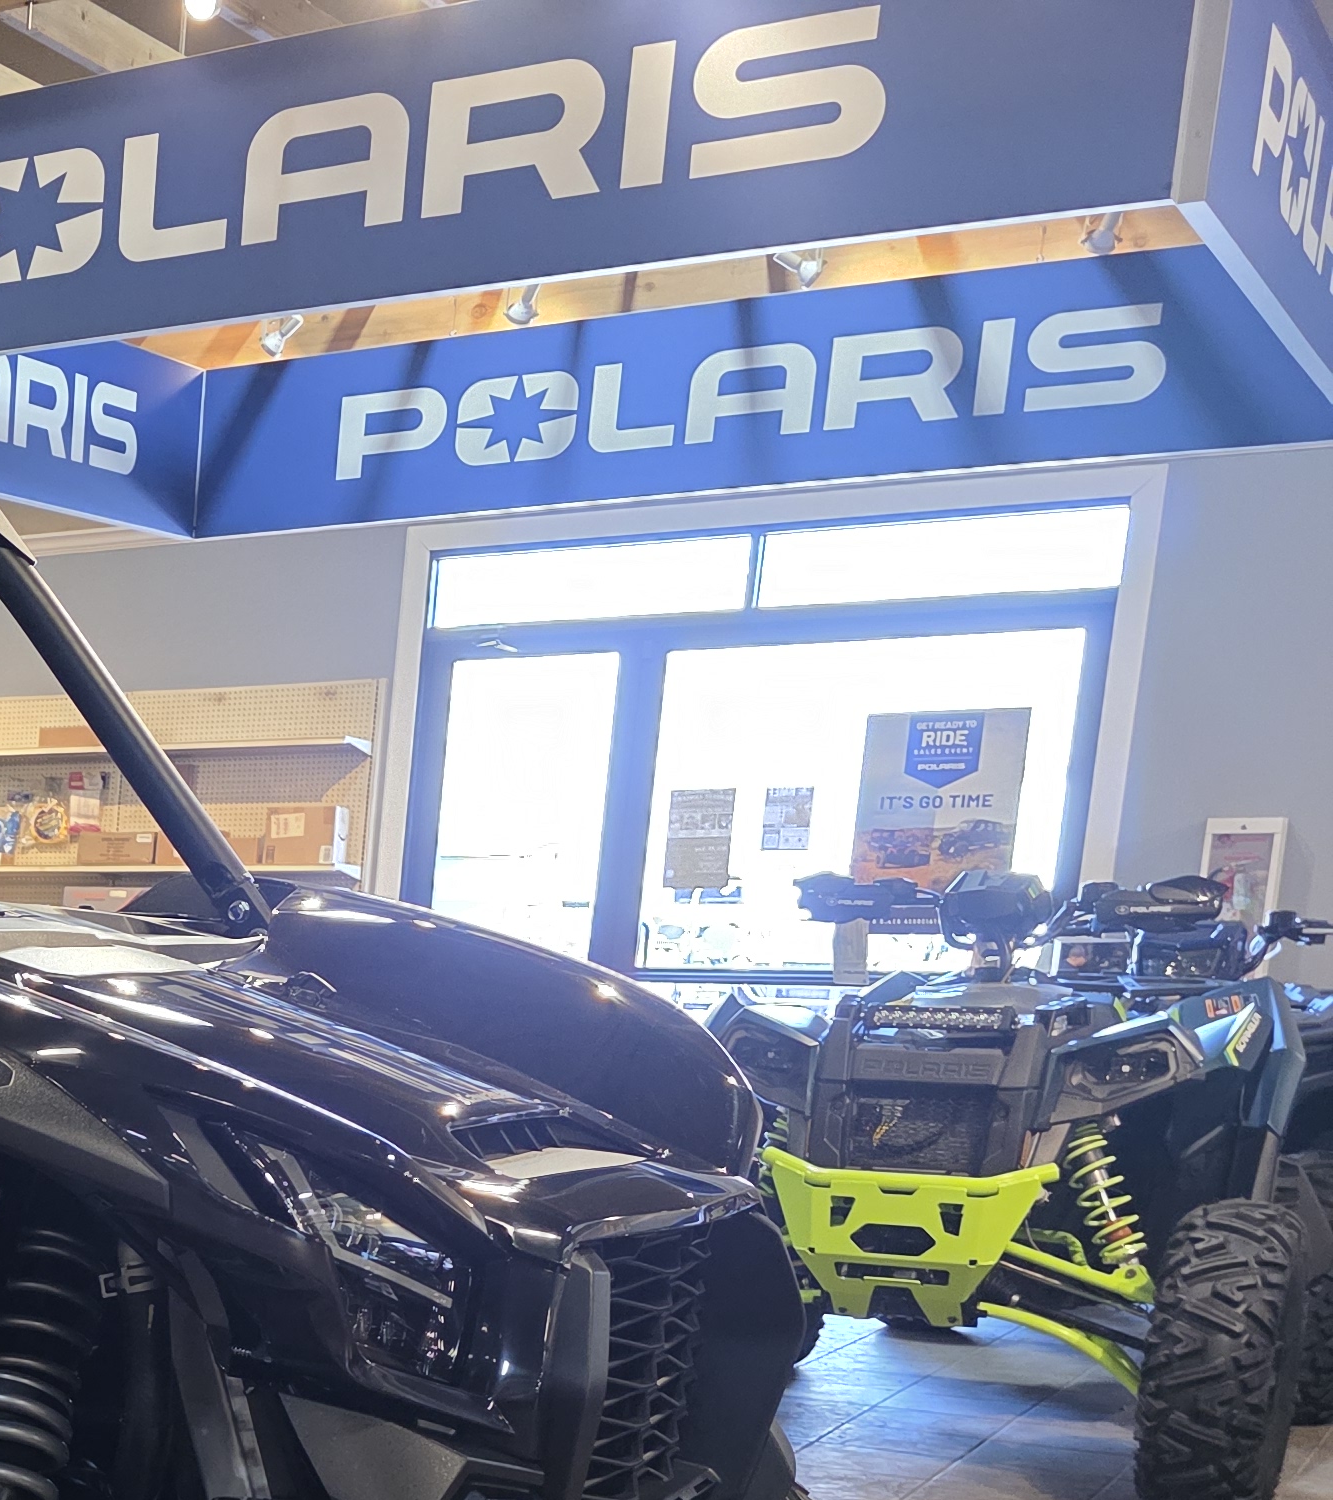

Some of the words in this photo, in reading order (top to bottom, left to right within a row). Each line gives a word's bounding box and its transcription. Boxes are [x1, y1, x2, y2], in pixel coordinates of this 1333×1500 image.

[334, 302, 1167, 481] POLARIS
[921, 729, 970, 747] RIDE
[917, 762, 966, 771] POLARIS
[879, 795, 915, 810] IT'S
[918, 794, 944, 809] GO
[948, 793, 994, 808] TIME
[861, 1056, 993, 1081] POLARIS
